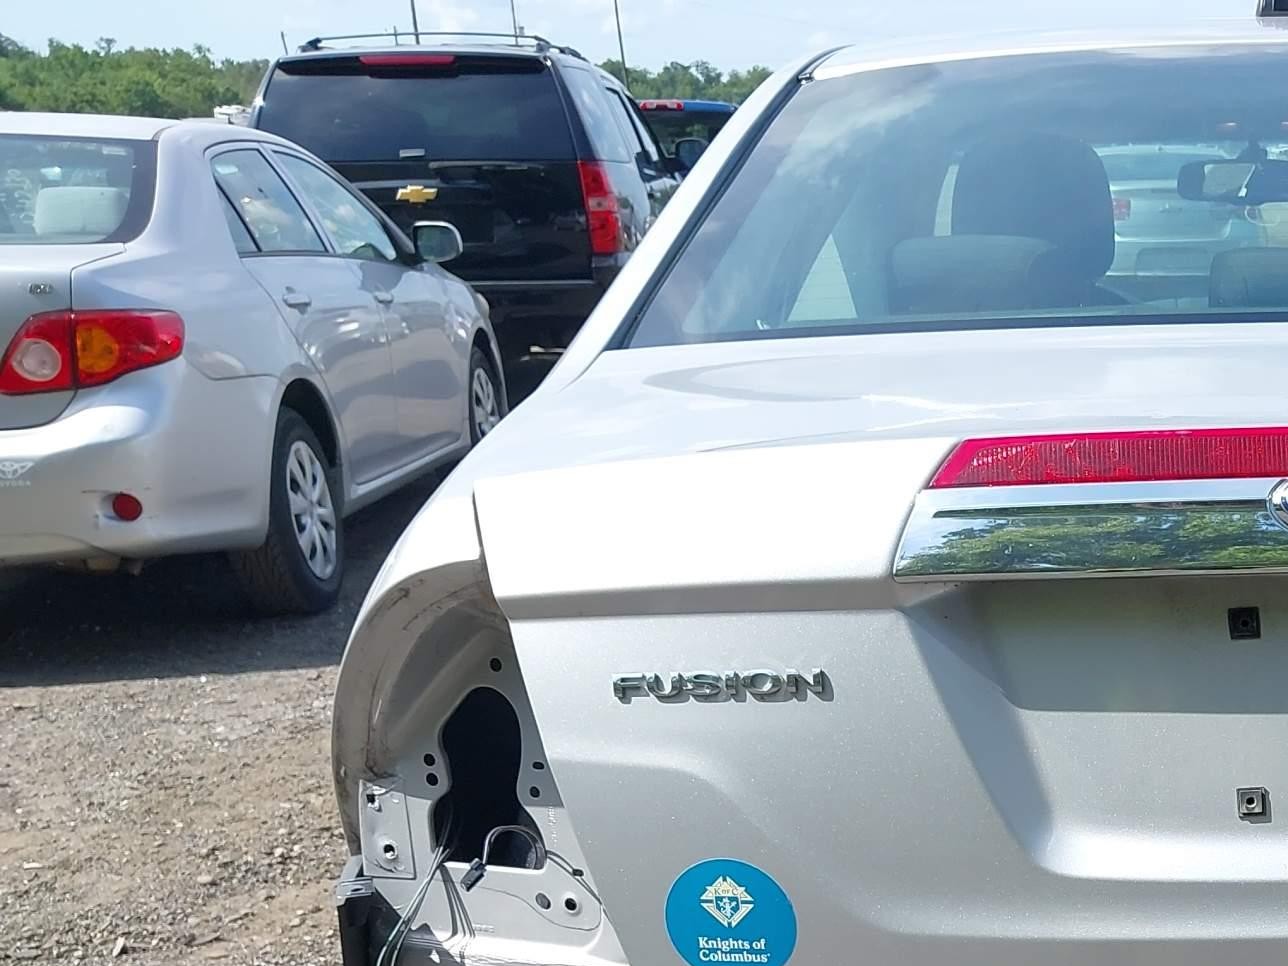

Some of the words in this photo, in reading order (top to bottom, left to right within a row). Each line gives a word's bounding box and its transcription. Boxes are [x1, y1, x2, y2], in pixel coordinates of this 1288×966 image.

[612, 669, 824, 698] FUSION
[698, 936, 751, 952] Knights
[752, 938, 766, 950] of
